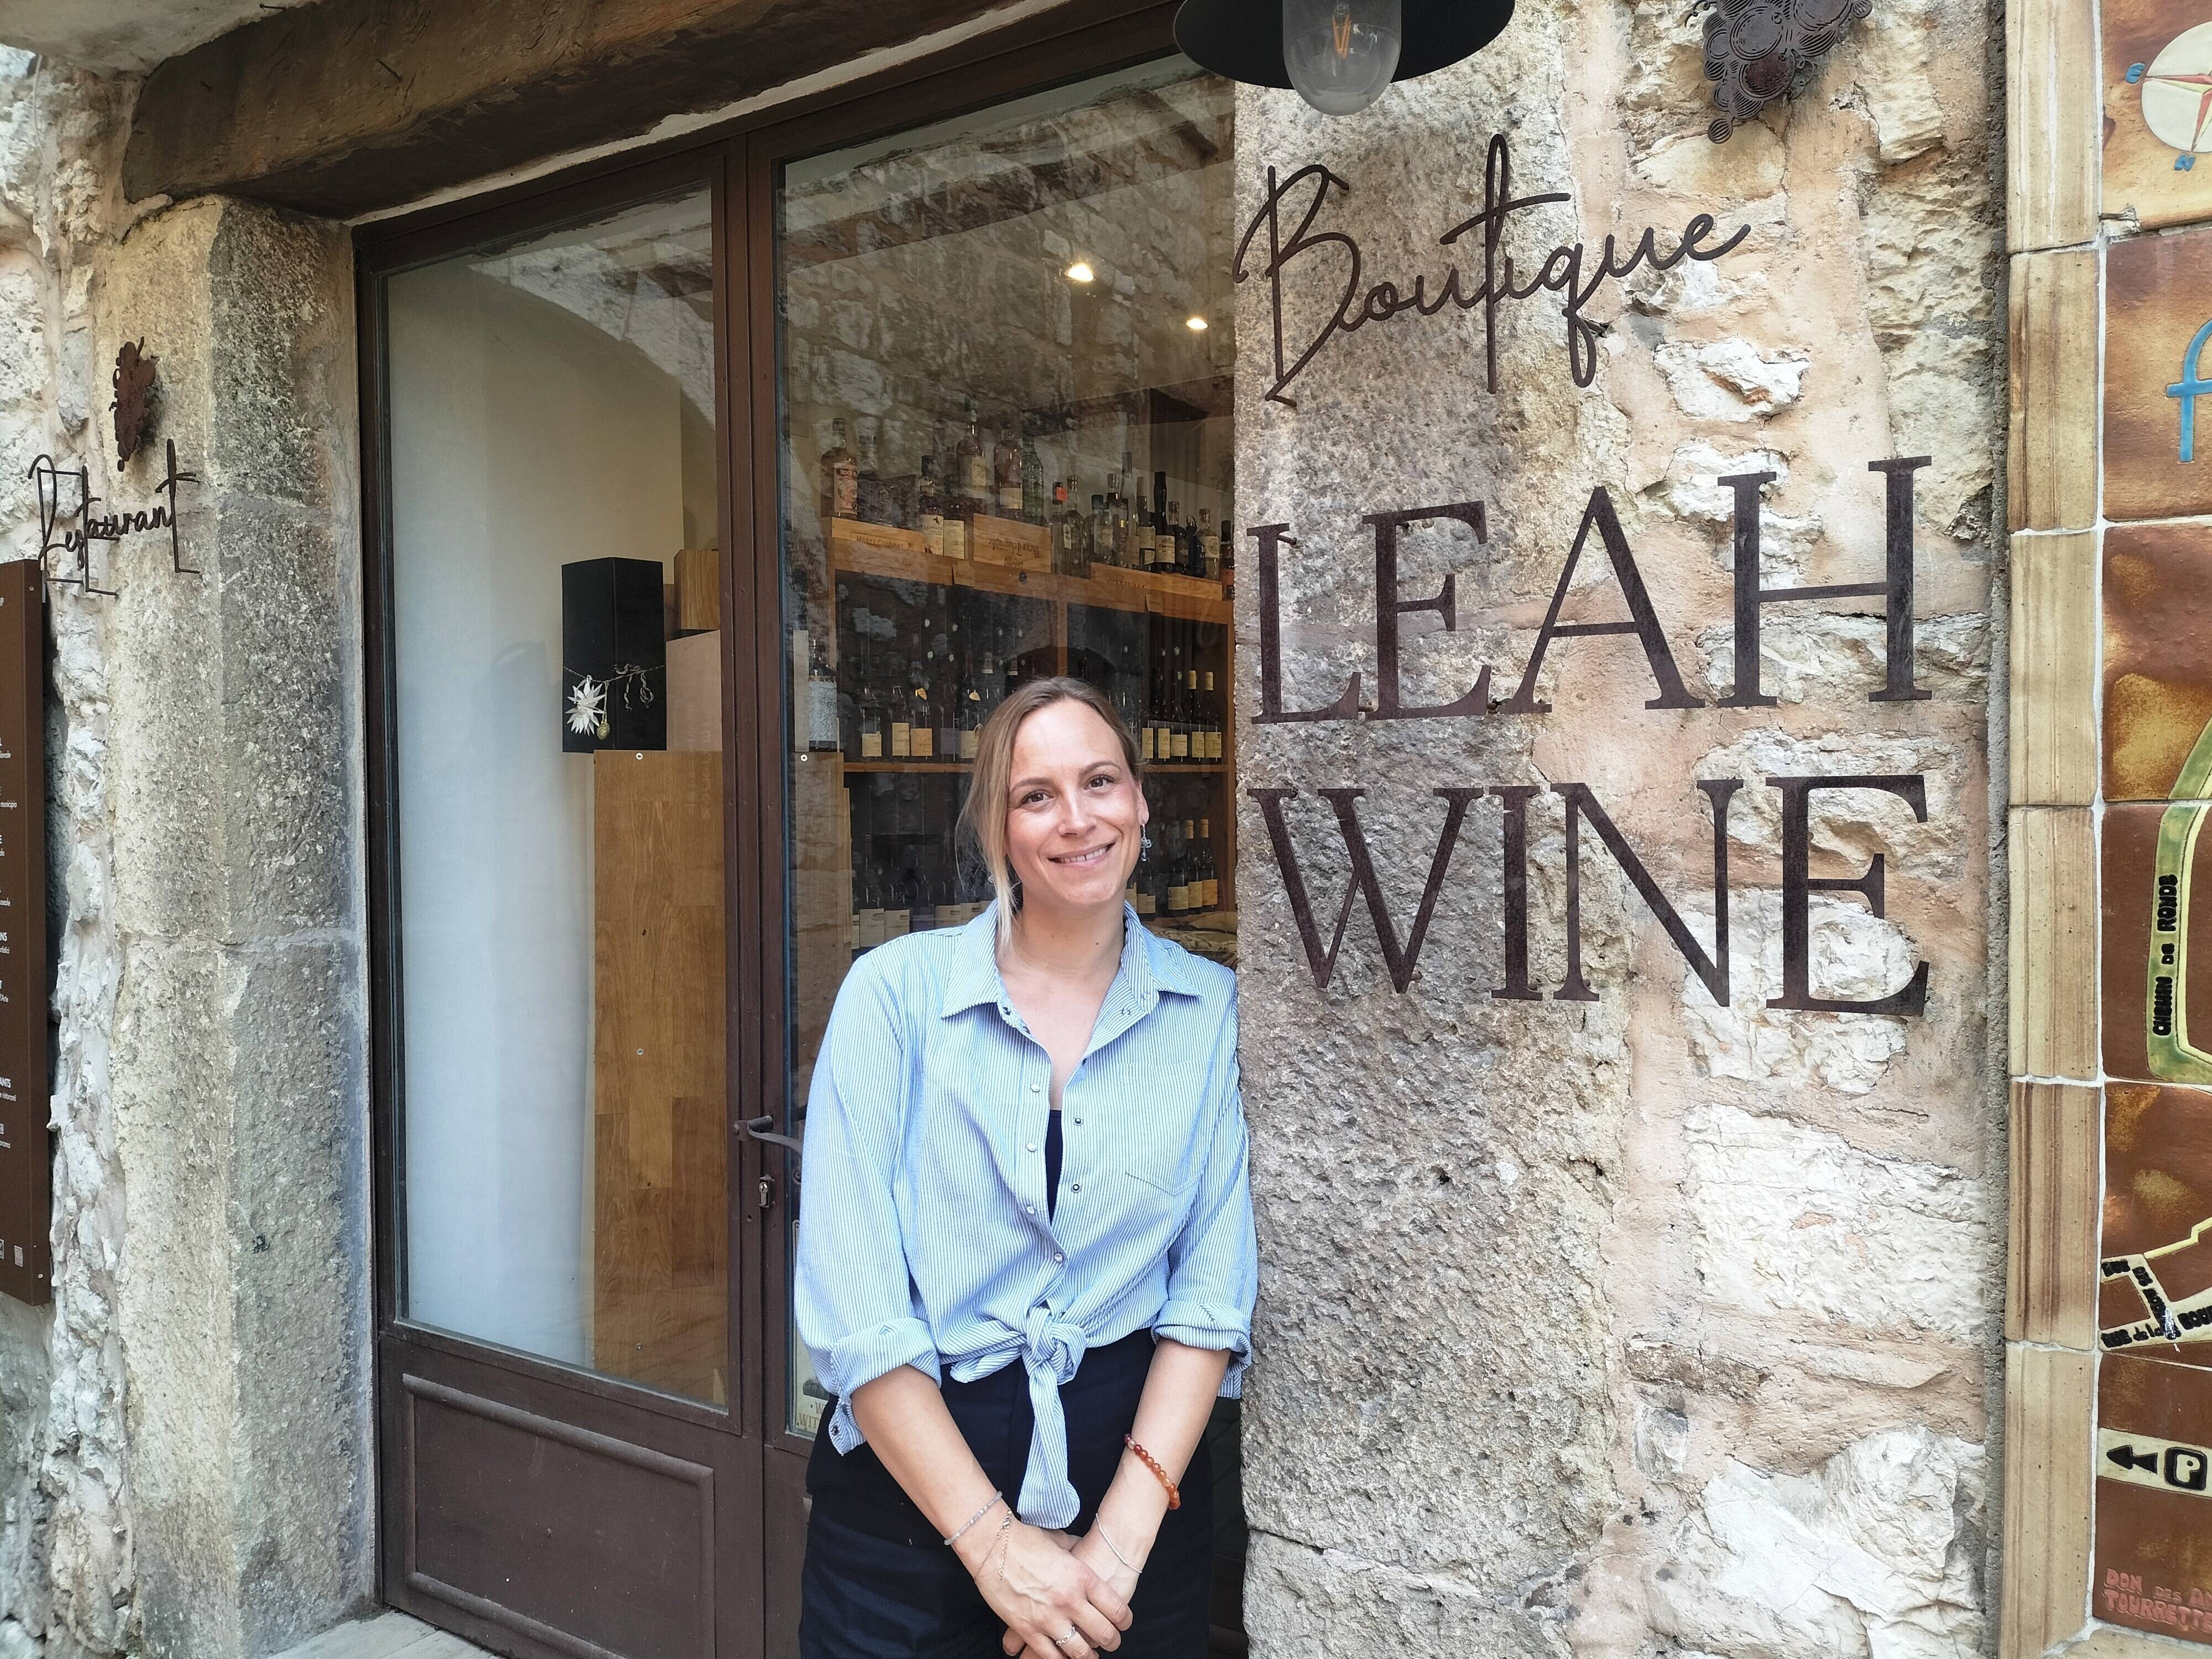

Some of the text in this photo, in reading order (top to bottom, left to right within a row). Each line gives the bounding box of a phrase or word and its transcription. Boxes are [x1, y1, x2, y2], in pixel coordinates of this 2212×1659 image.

[1235, 134, 1751, 407] Boutique
[1246, 456, 1932, 724] LEAH
[1246, 775, 1930, 1016] WINE
[2157, 874, 2178, 932] RONDE
[800, 1413, 820, 1429] WIT
[2176, 1453, 2200, 1483] P
[2104, 1567, 2143, 1595] DON
[2153, 1586, 2183, 1604] DES
